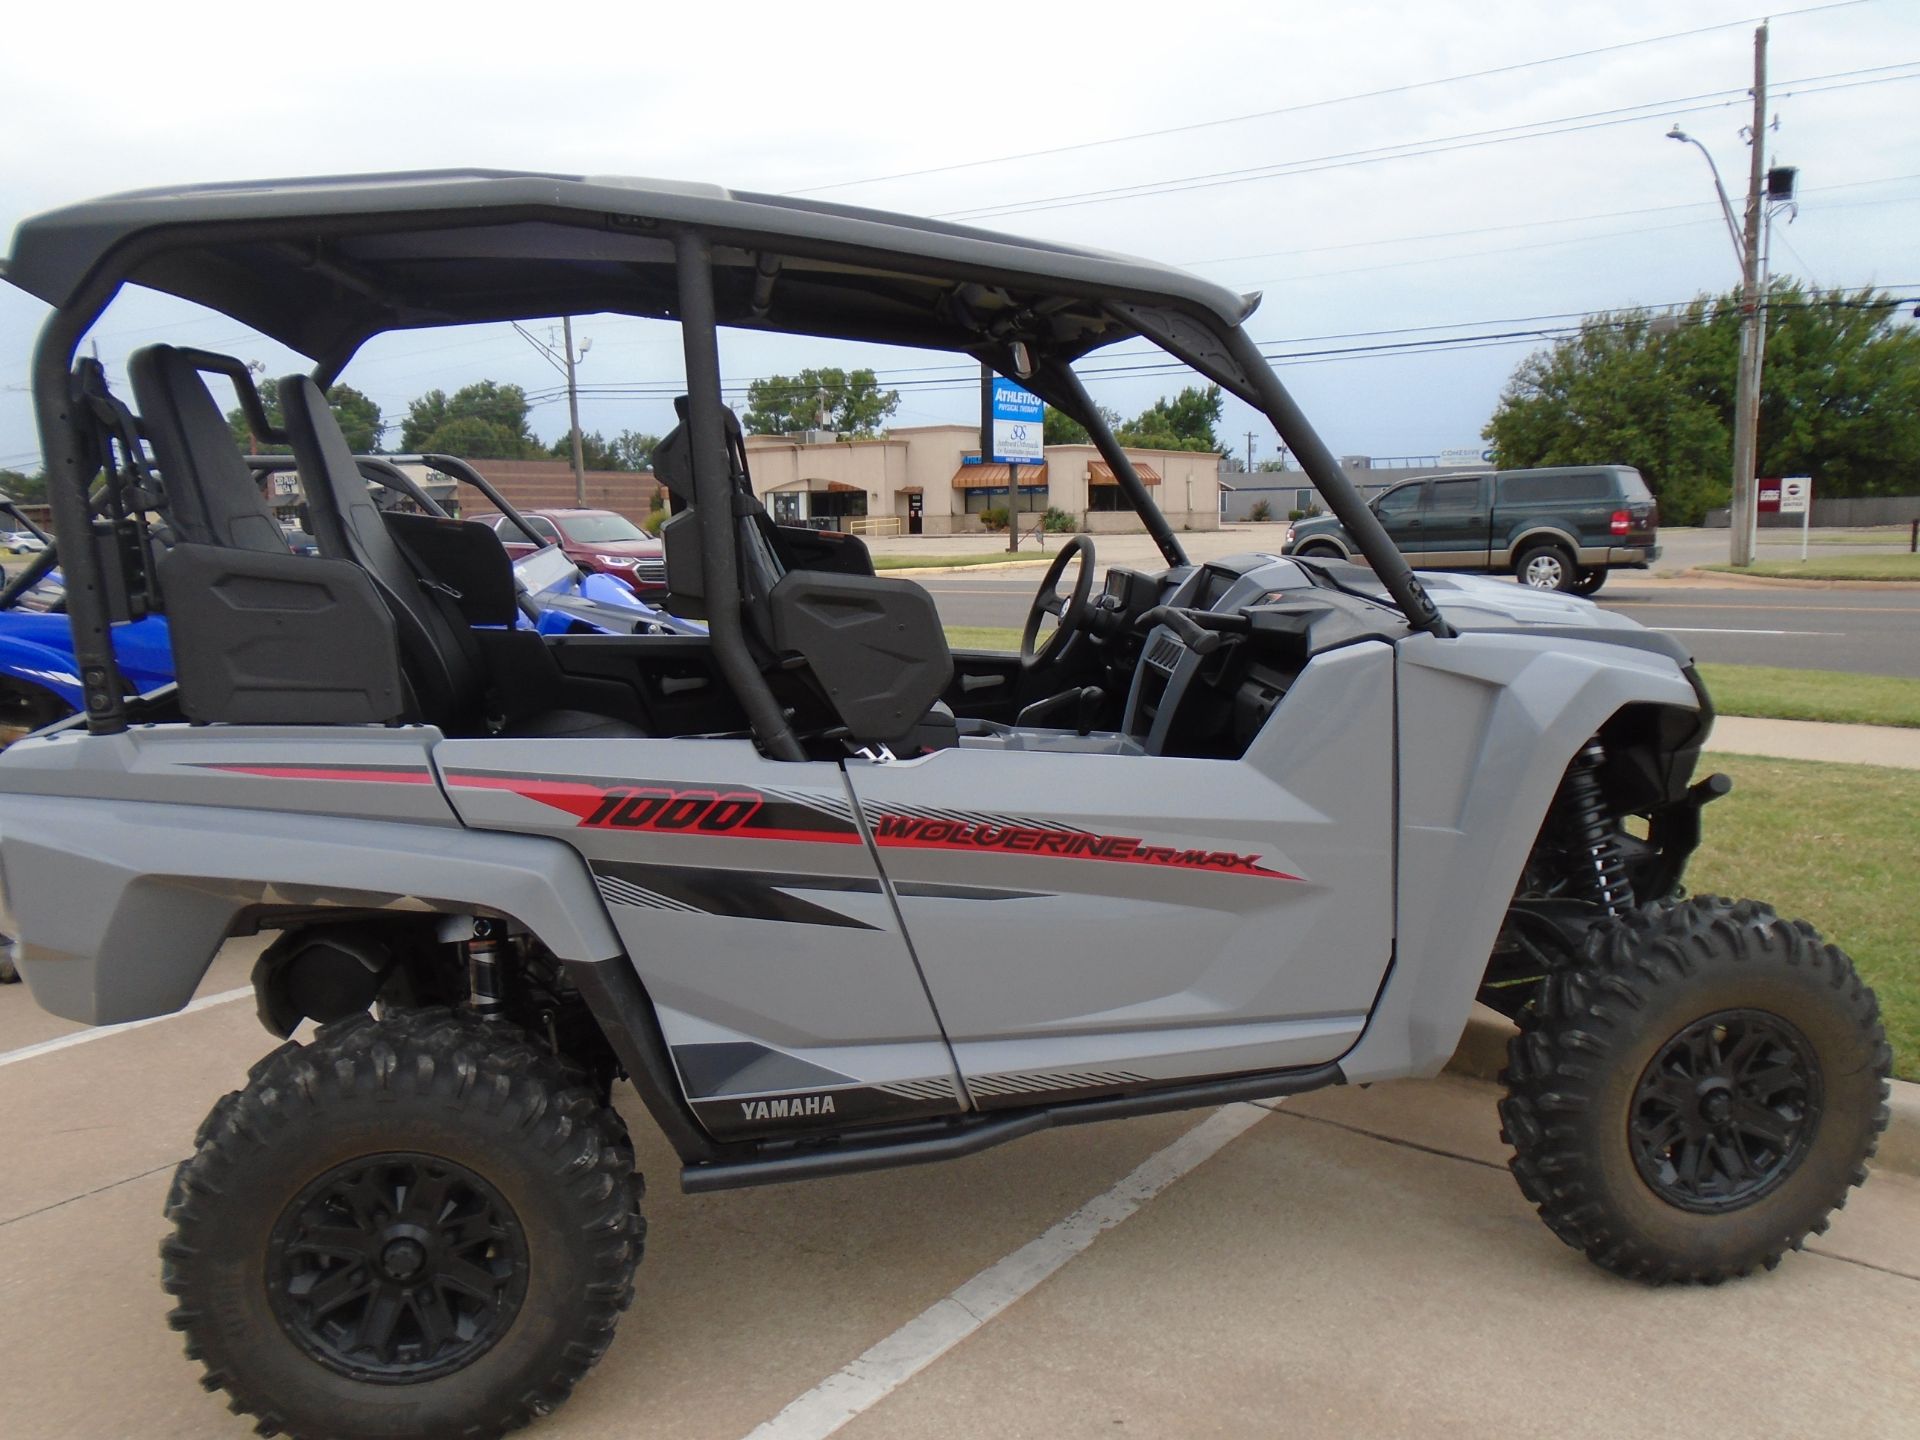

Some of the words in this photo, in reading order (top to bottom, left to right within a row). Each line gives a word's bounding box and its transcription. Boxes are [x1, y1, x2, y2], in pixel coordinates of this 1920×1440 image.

[995, 387, 1041, 405] ATHLETICO
[583, 786, 765, 832] 1000
[879, 812, 1142, 858] WOLVERINE
[741, 1095, 836, 1120] YAMAHA
